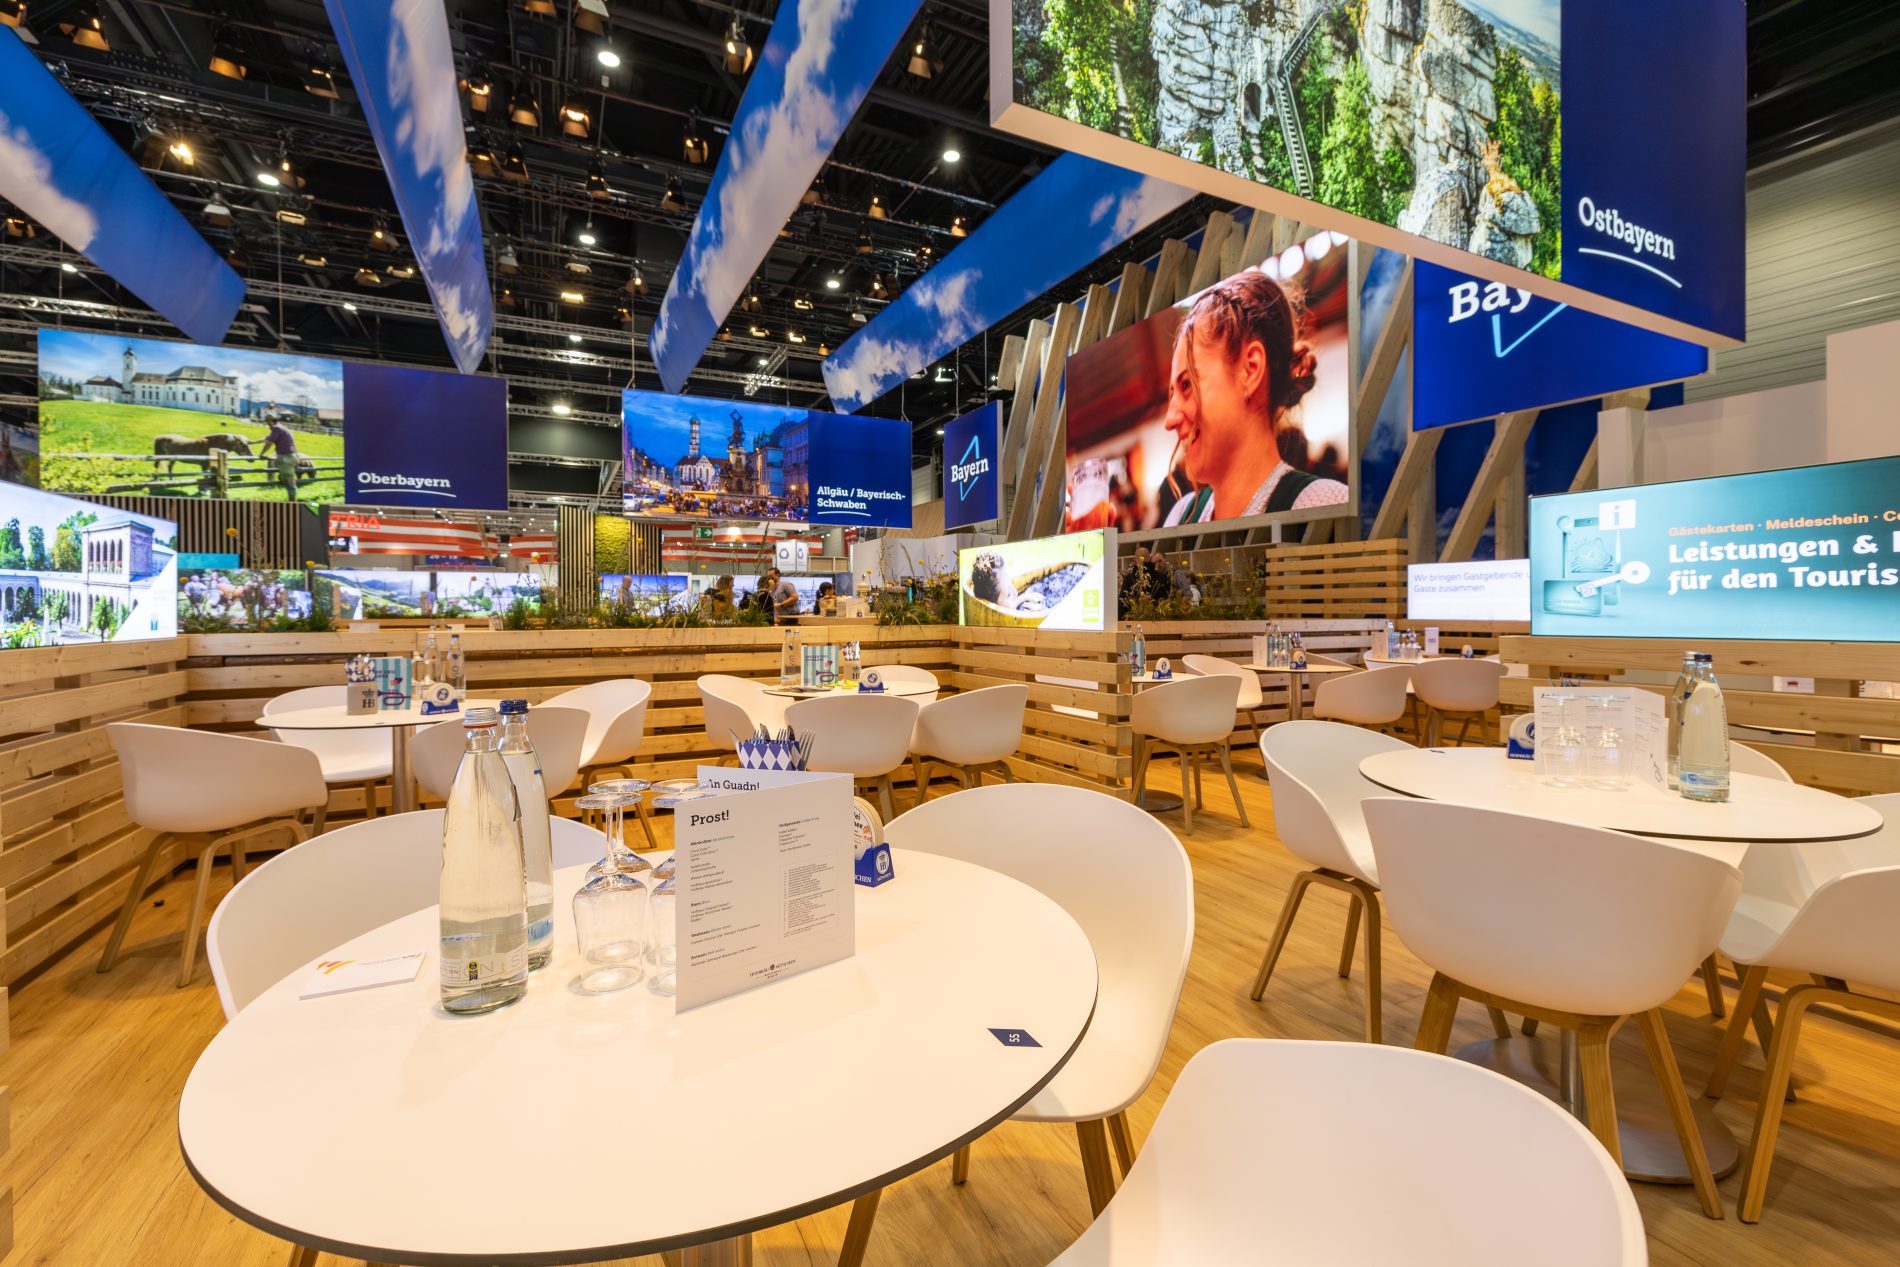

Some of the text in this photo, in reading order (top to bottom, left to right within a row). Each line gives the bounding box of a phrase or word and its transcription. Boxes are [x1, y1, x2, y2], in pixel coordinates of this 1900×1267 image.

[1578, 196, 1675, 260] Ostbayern
[951, 458, 989, 483] Bayern
[358, 472, 451, 488] Oberbayern
[817, 486, 906, 500] Allgäu / Bayerisch-
[817, 498, 867, 509] Schwaben
[329, 514, 381, 529] TRIA
[1668, 523, 1754, 537] Gästekarten
[1766, 513, 1869, 529] Meldeschein
[1669, 539, 1839, 563] Leistungen
[1853, 534, 1879, 554] &
[1414, 573, 1427, 582] Wir
[1429, 572, 1461, 583] bringen
[1463, 570, 1524, 582] Gastgebende
[1668, 562, 1900, 595] für den Touris
[1414, 583, 1485, 593] Gäste zusammen
[723, 779, 760, 791] Guadn!
[690, 809, 730, 827] Prost!
[855, 874, 872, 884] CHEN
[1009, 1033, 1020, 1043] 55
